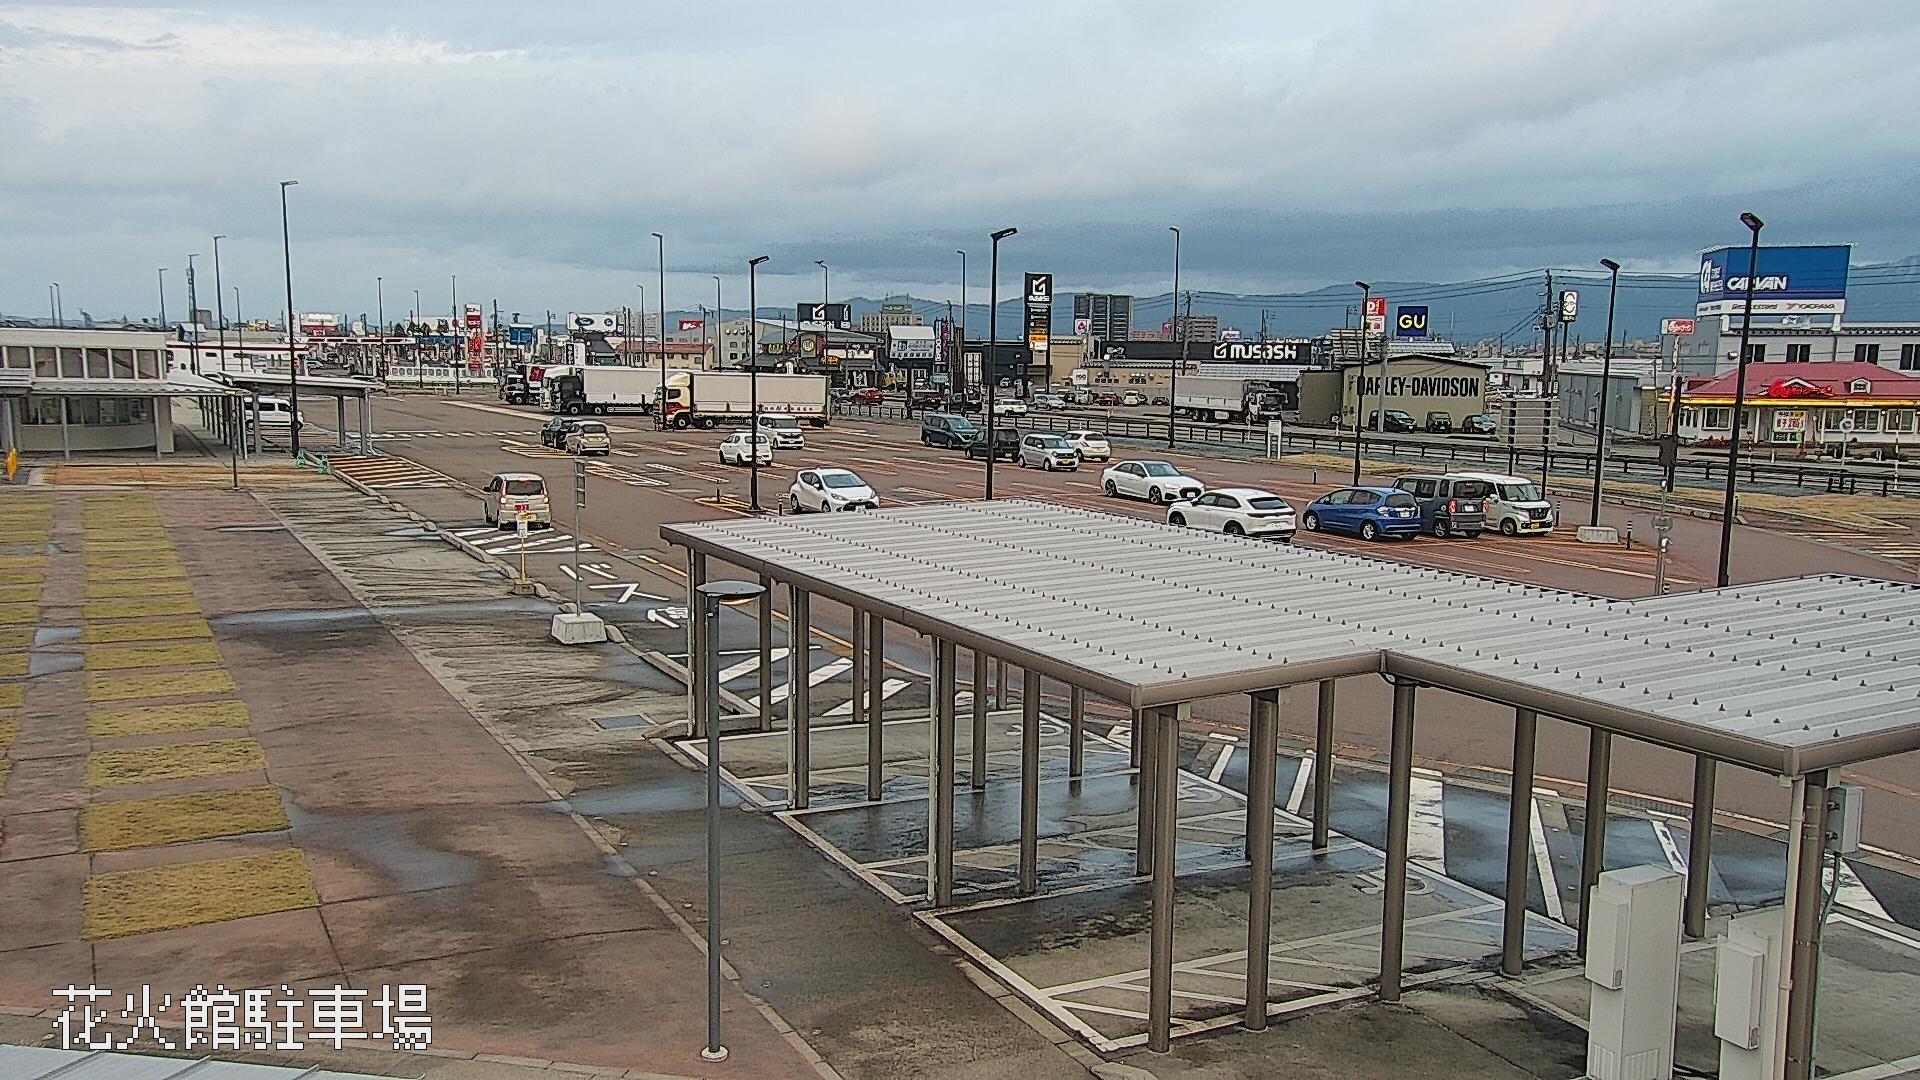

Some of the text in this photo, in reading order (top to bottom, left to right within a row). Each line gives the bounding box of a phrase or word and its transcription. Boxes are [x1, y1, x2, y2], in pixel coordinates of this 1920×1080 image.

[1726, 276, 1788, 291] CAVAN
[1399, 314, 1426, 329] GU
[1356, 376, 1480, 397] ARLEY-DAVIDSON
